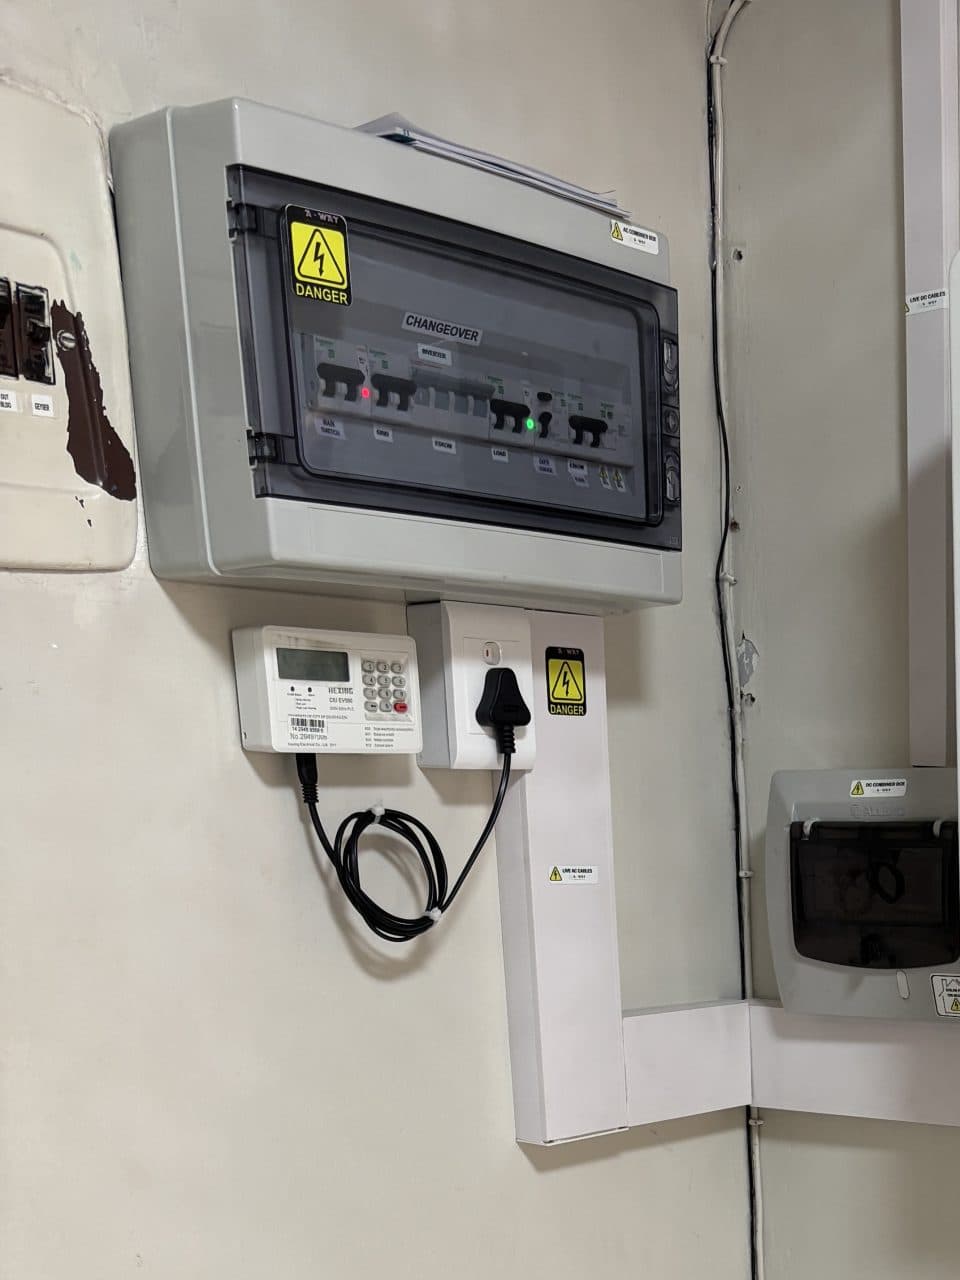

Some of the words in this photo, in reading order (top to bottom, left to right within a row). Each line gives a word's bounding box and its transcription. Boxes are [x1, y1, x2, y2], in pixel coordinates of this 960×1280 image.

[296, 283, 348, 305] DANGER
[406, 315, 479, 342] CHANGEOVER
[550, 704, 585, 715] DANGER
